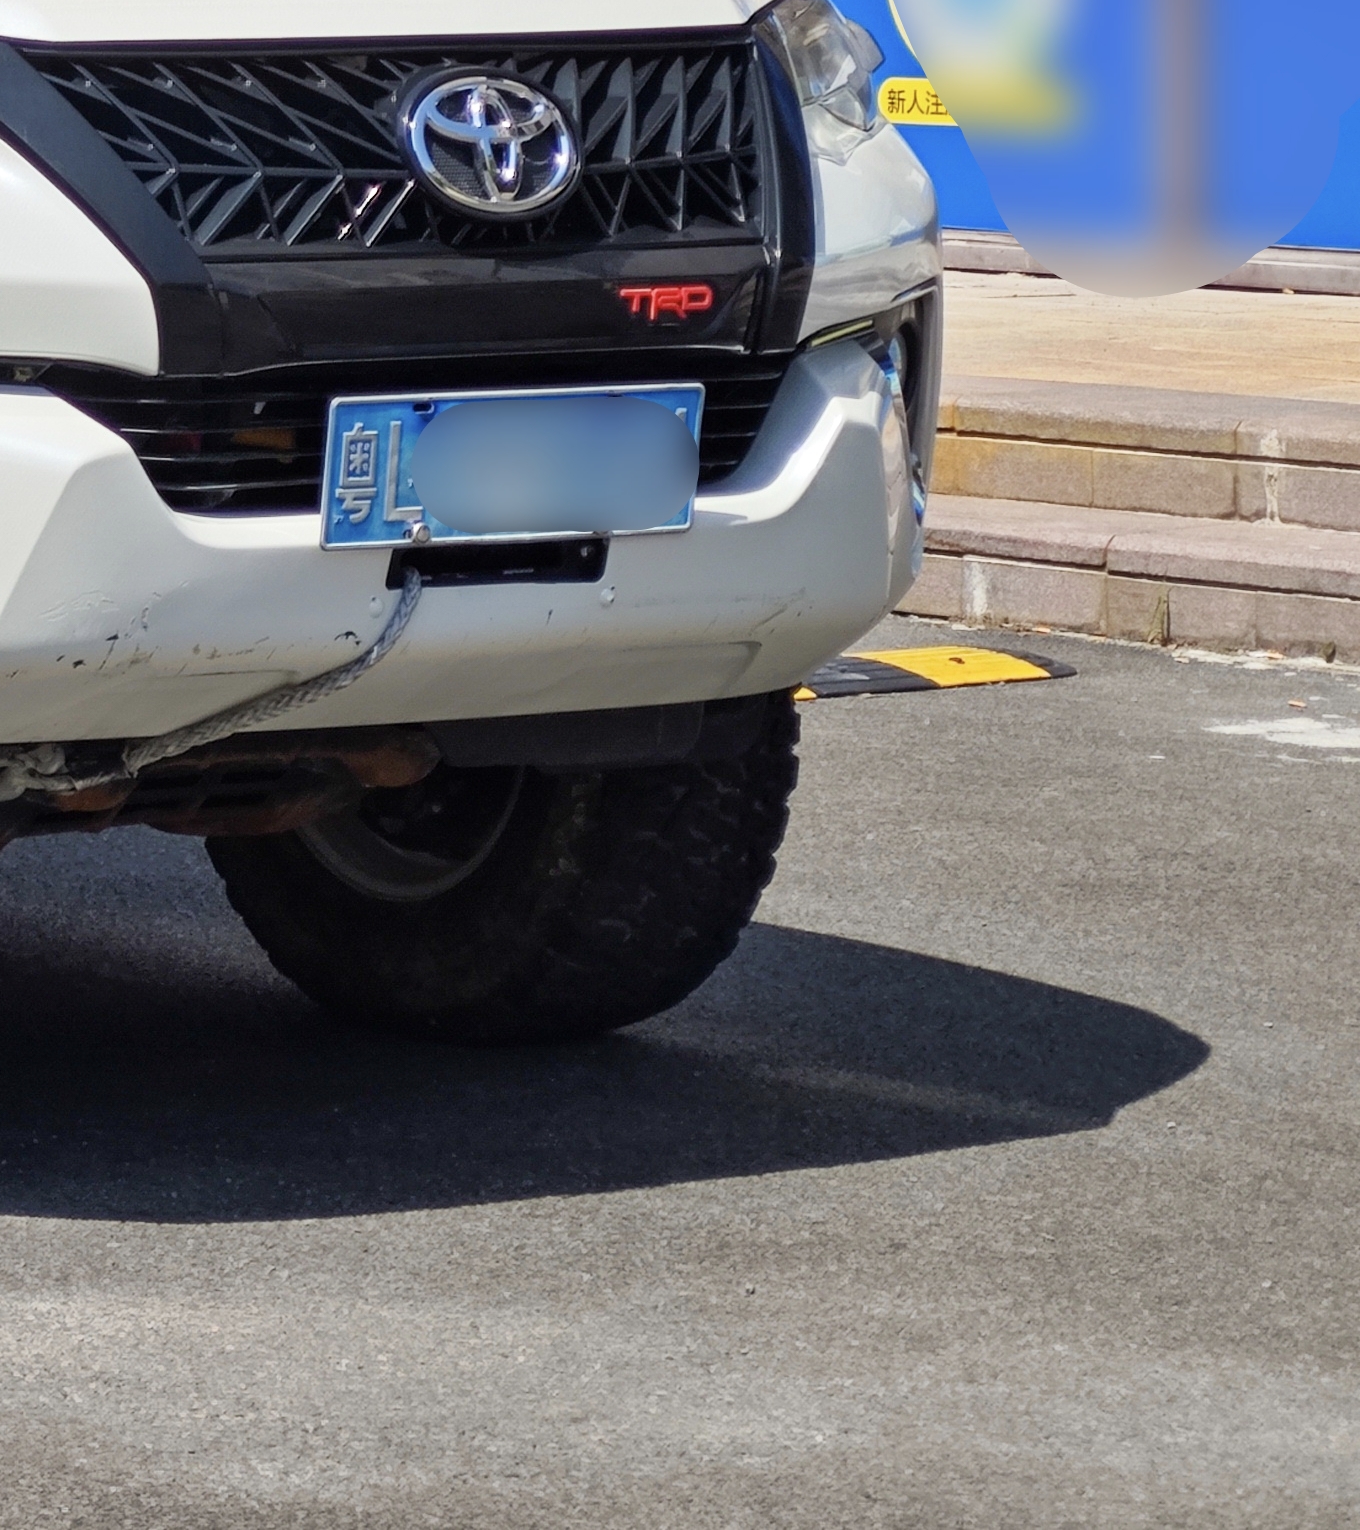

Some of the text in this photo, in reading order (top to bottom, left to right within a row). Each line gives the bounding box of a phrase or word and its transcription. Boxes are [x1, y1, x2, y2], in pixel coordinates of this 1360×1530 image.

[887, 88, 950, 116] 新人注
[620, 285, 712, 320] TRD
